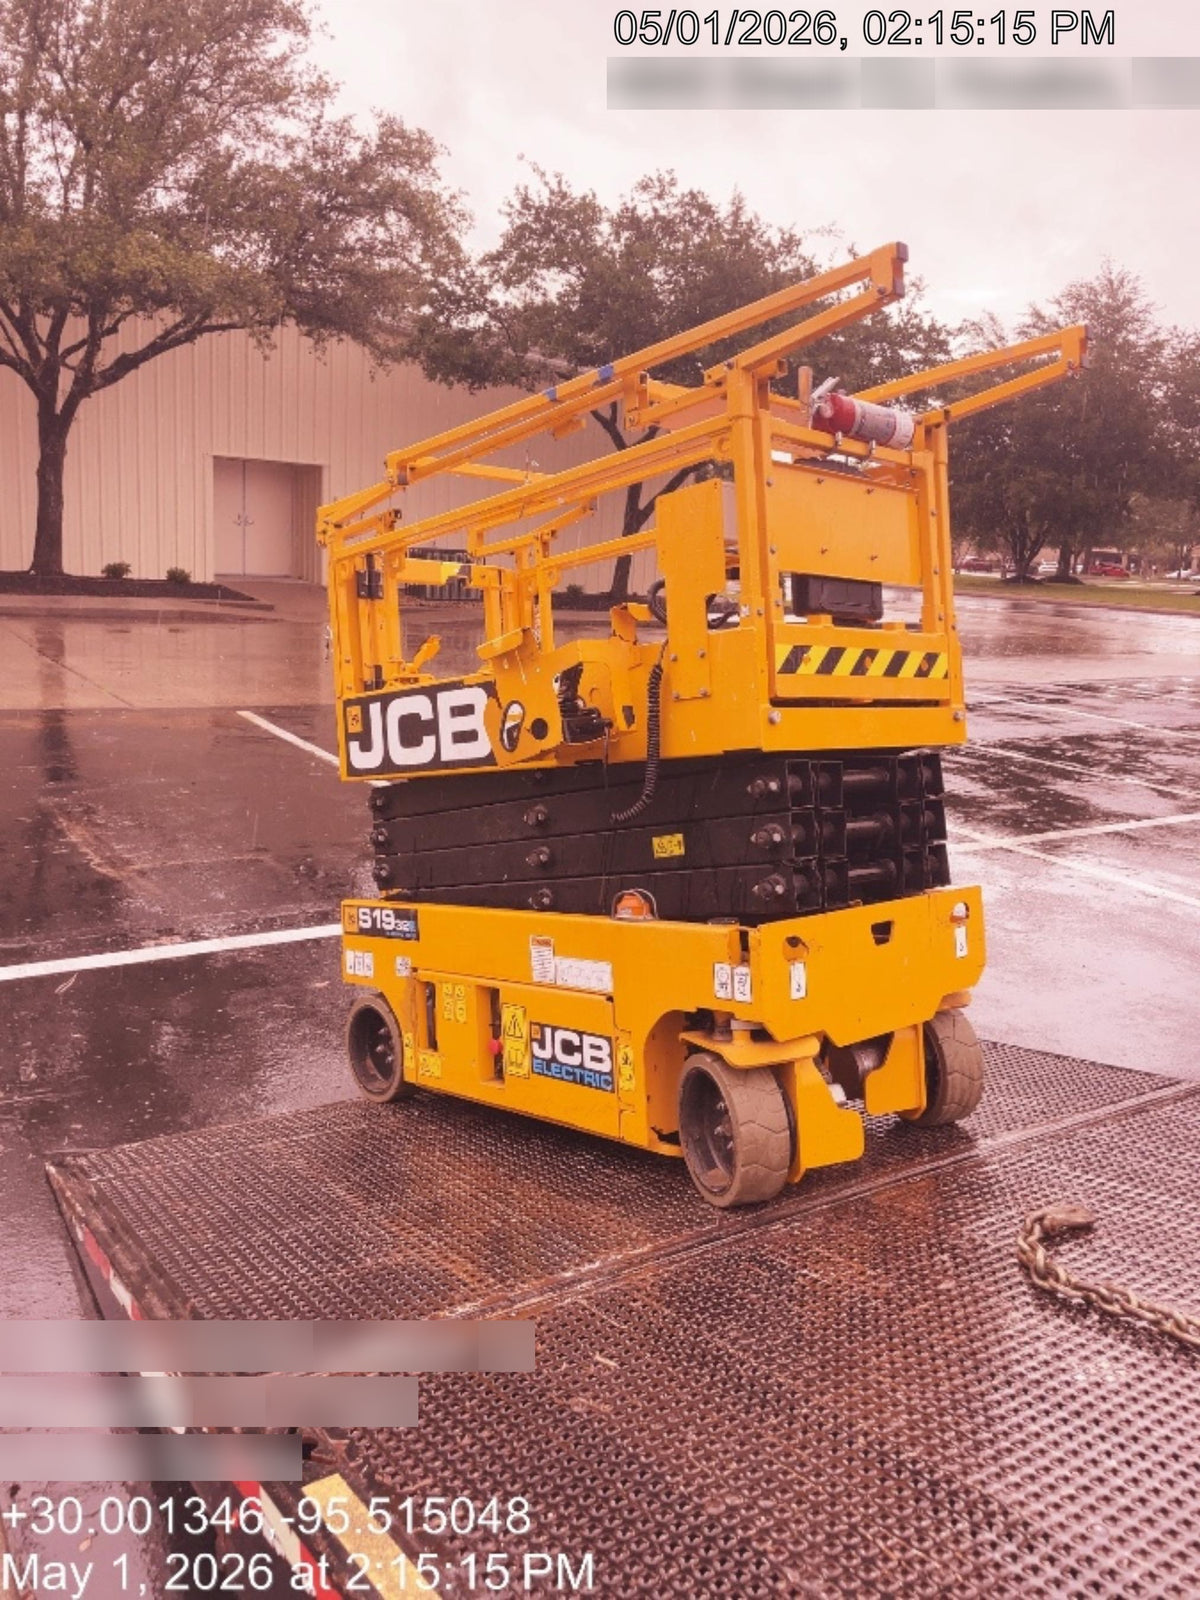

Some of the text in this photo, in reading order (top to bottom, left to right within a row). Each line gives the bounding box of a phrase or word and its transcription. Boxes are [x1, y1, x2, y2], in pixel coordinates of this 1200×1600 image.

[348, 686, 492, 769] JCB
[532, 1027, 612, 1073] JCB
[533, 1058, 612, 1091] ELECTRIC
